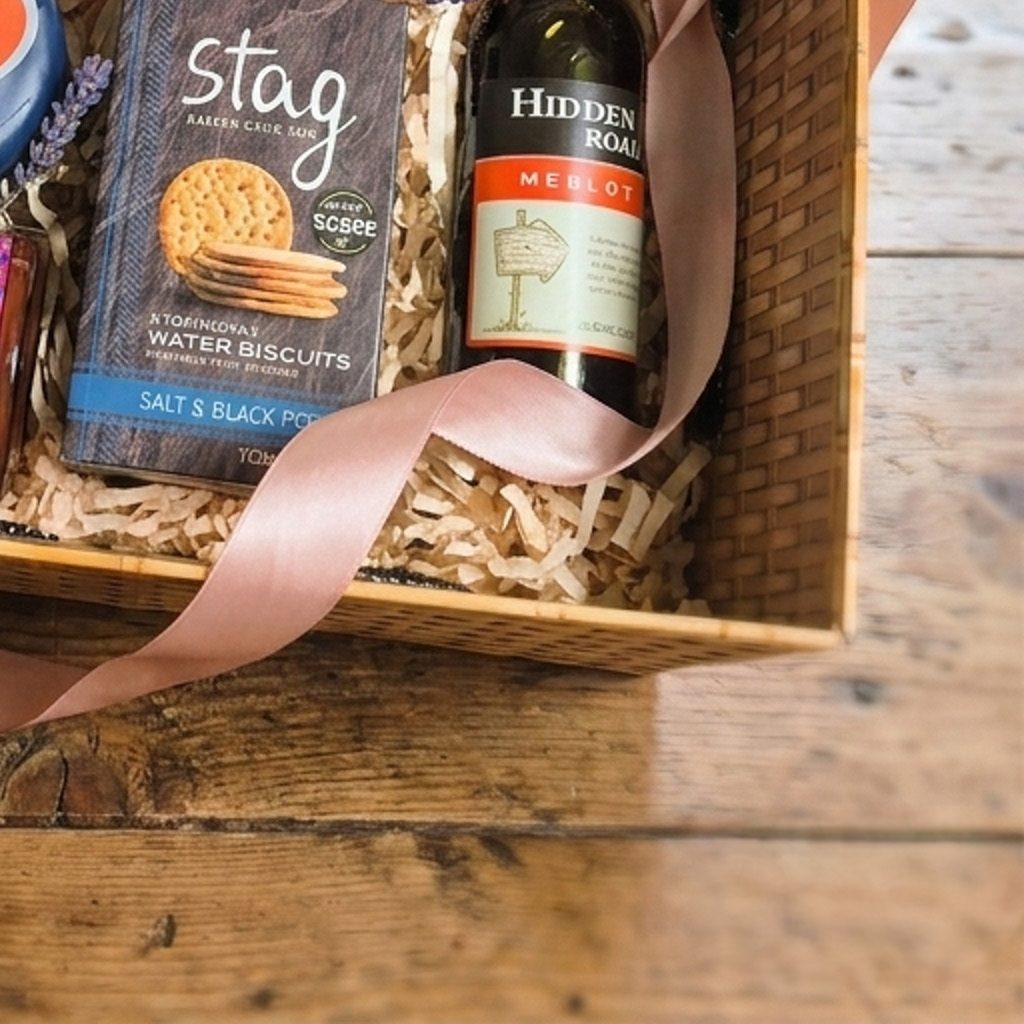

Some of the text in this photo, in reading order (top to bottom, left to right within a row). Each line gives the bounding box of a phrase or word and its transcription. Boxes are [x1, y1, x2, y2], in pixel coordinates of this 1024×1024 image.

[148, 329, 232, 356] WATER
[238, 341, 352, 372] BISCUITS
[139, 391, 186, 414] SALT
[211, 401, 275, 426] BLACK
